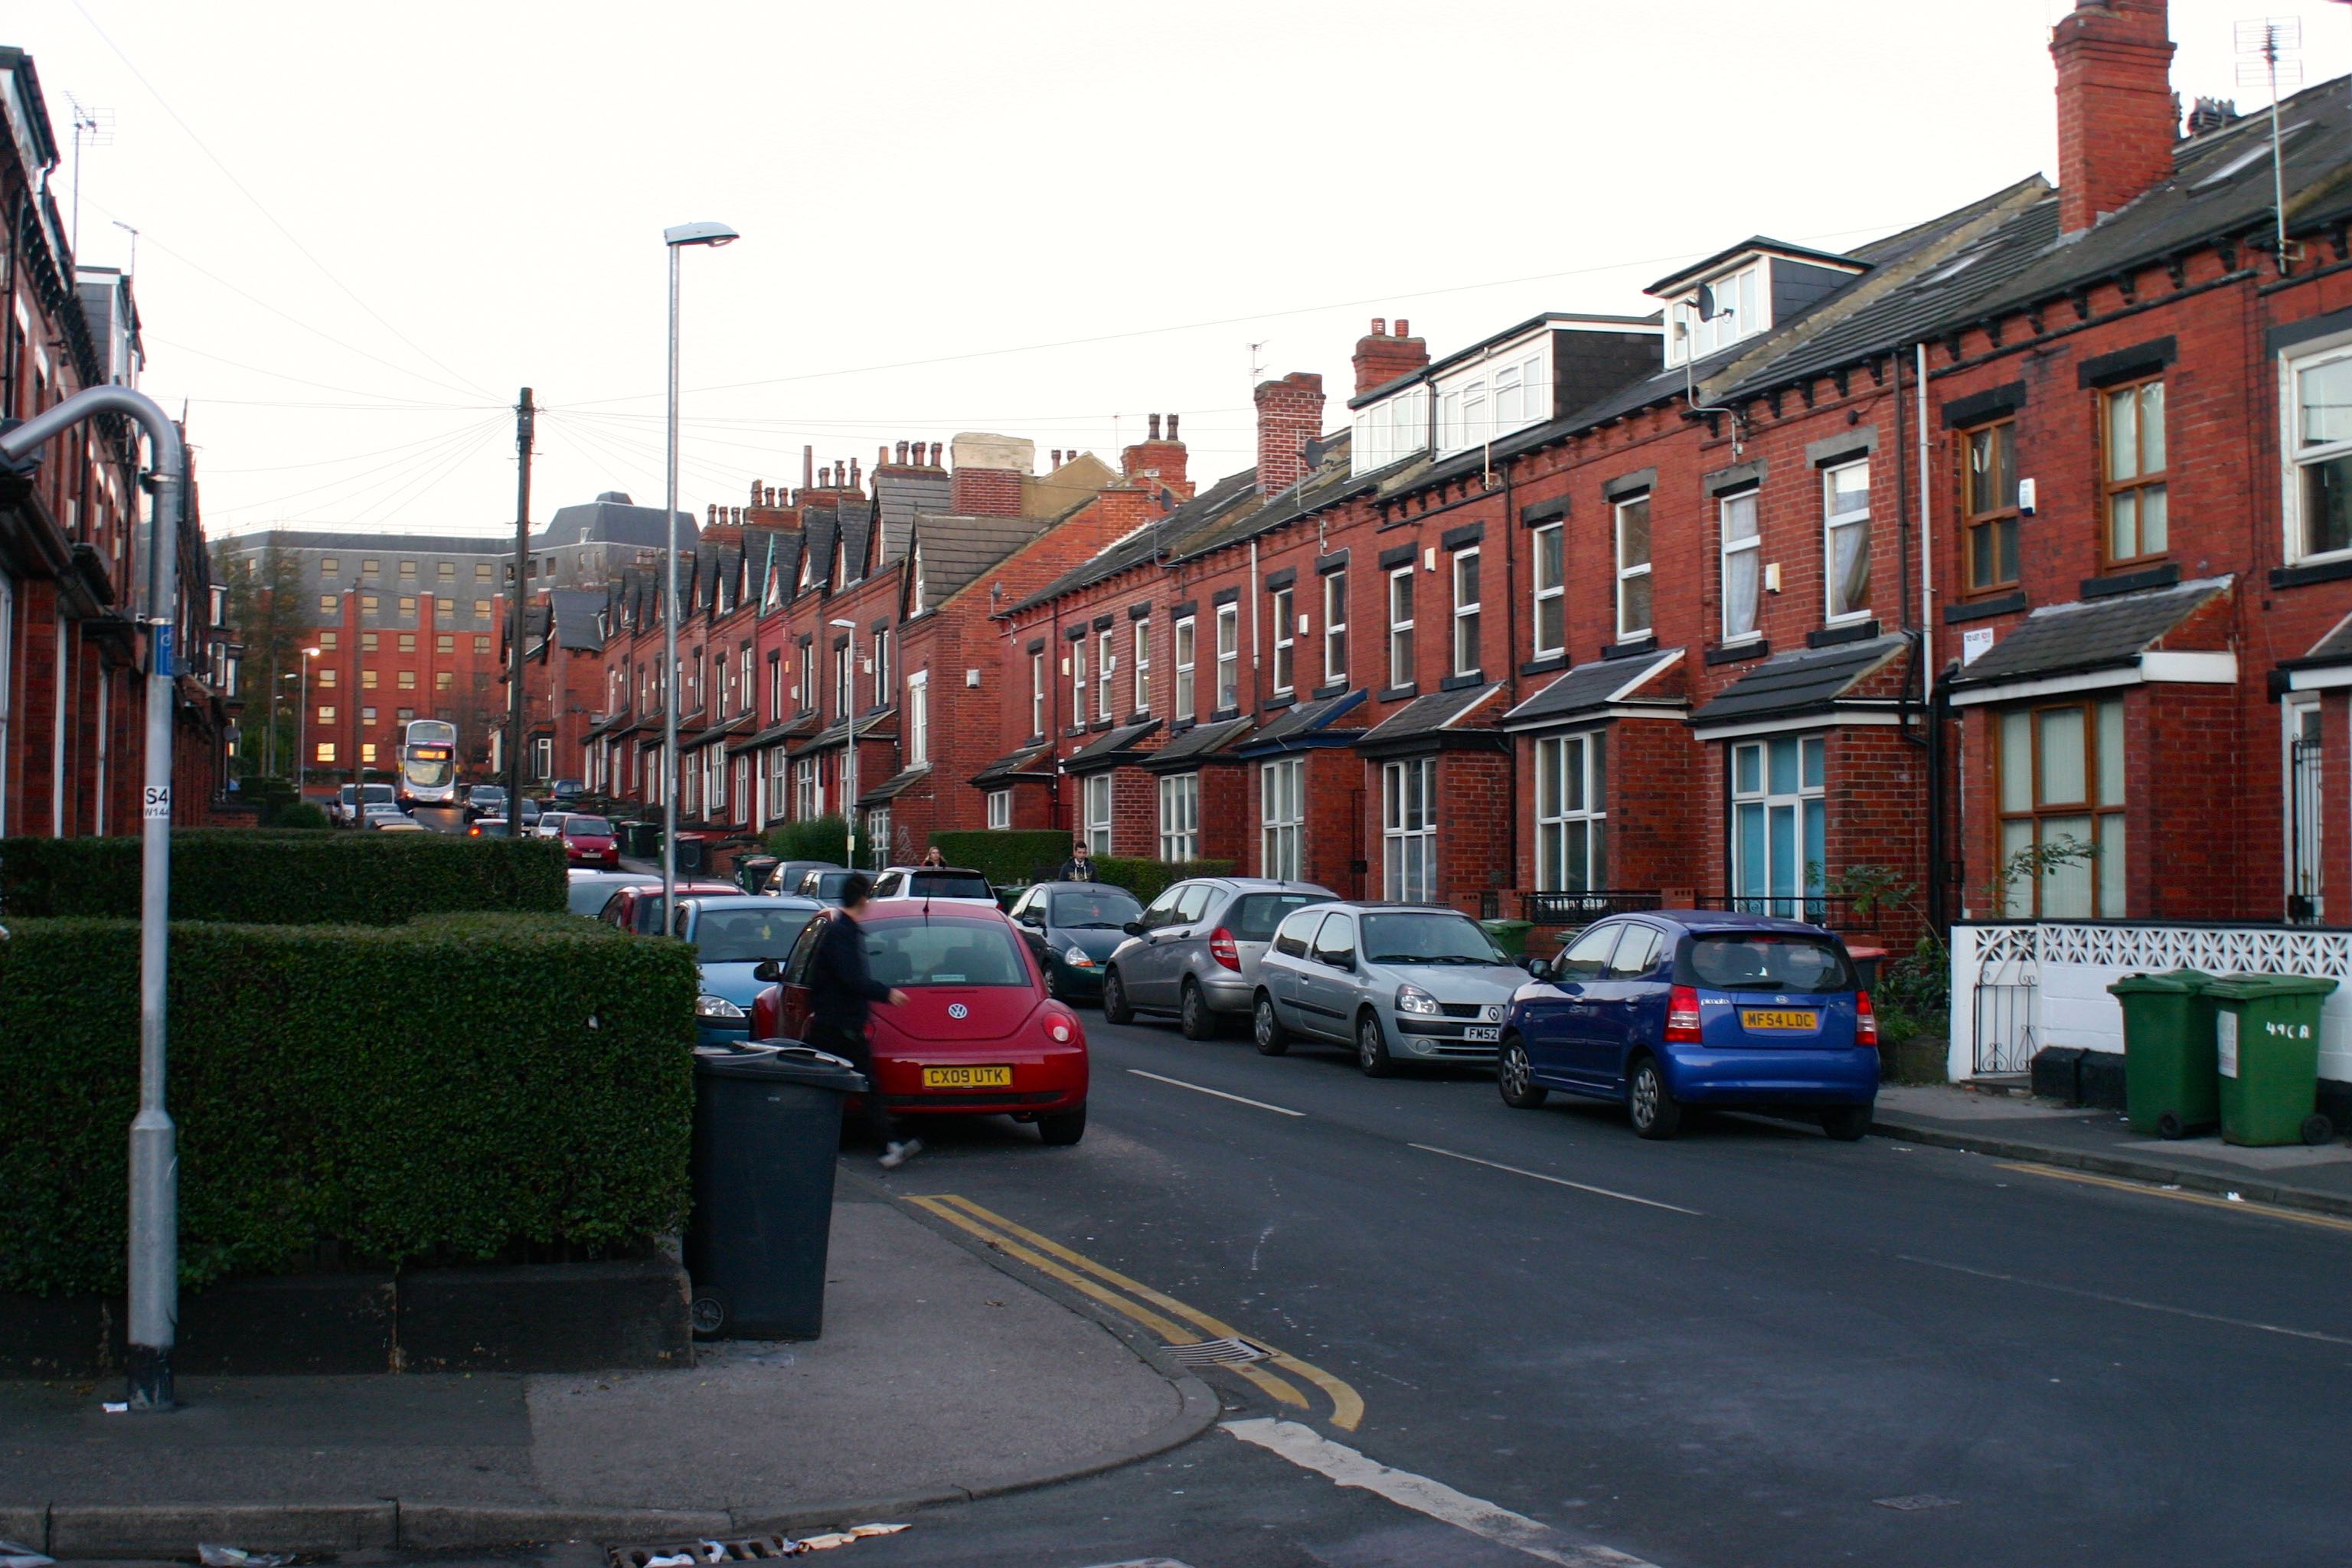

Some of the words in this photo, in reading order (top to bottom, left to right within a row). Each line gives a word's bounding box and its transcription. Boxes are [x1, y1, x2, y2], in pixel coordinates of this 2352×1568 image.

[145, 787, 168, 805] S4
[1747, 1012, 1784, 1026] MF54
[1786, 1014, 1812, 1027] LDC
[1468, 1027, 1498, 1040] FM52
[929, 1070, 971, 1084] CX09
[973, 1069, 1004, 1083] UTK
